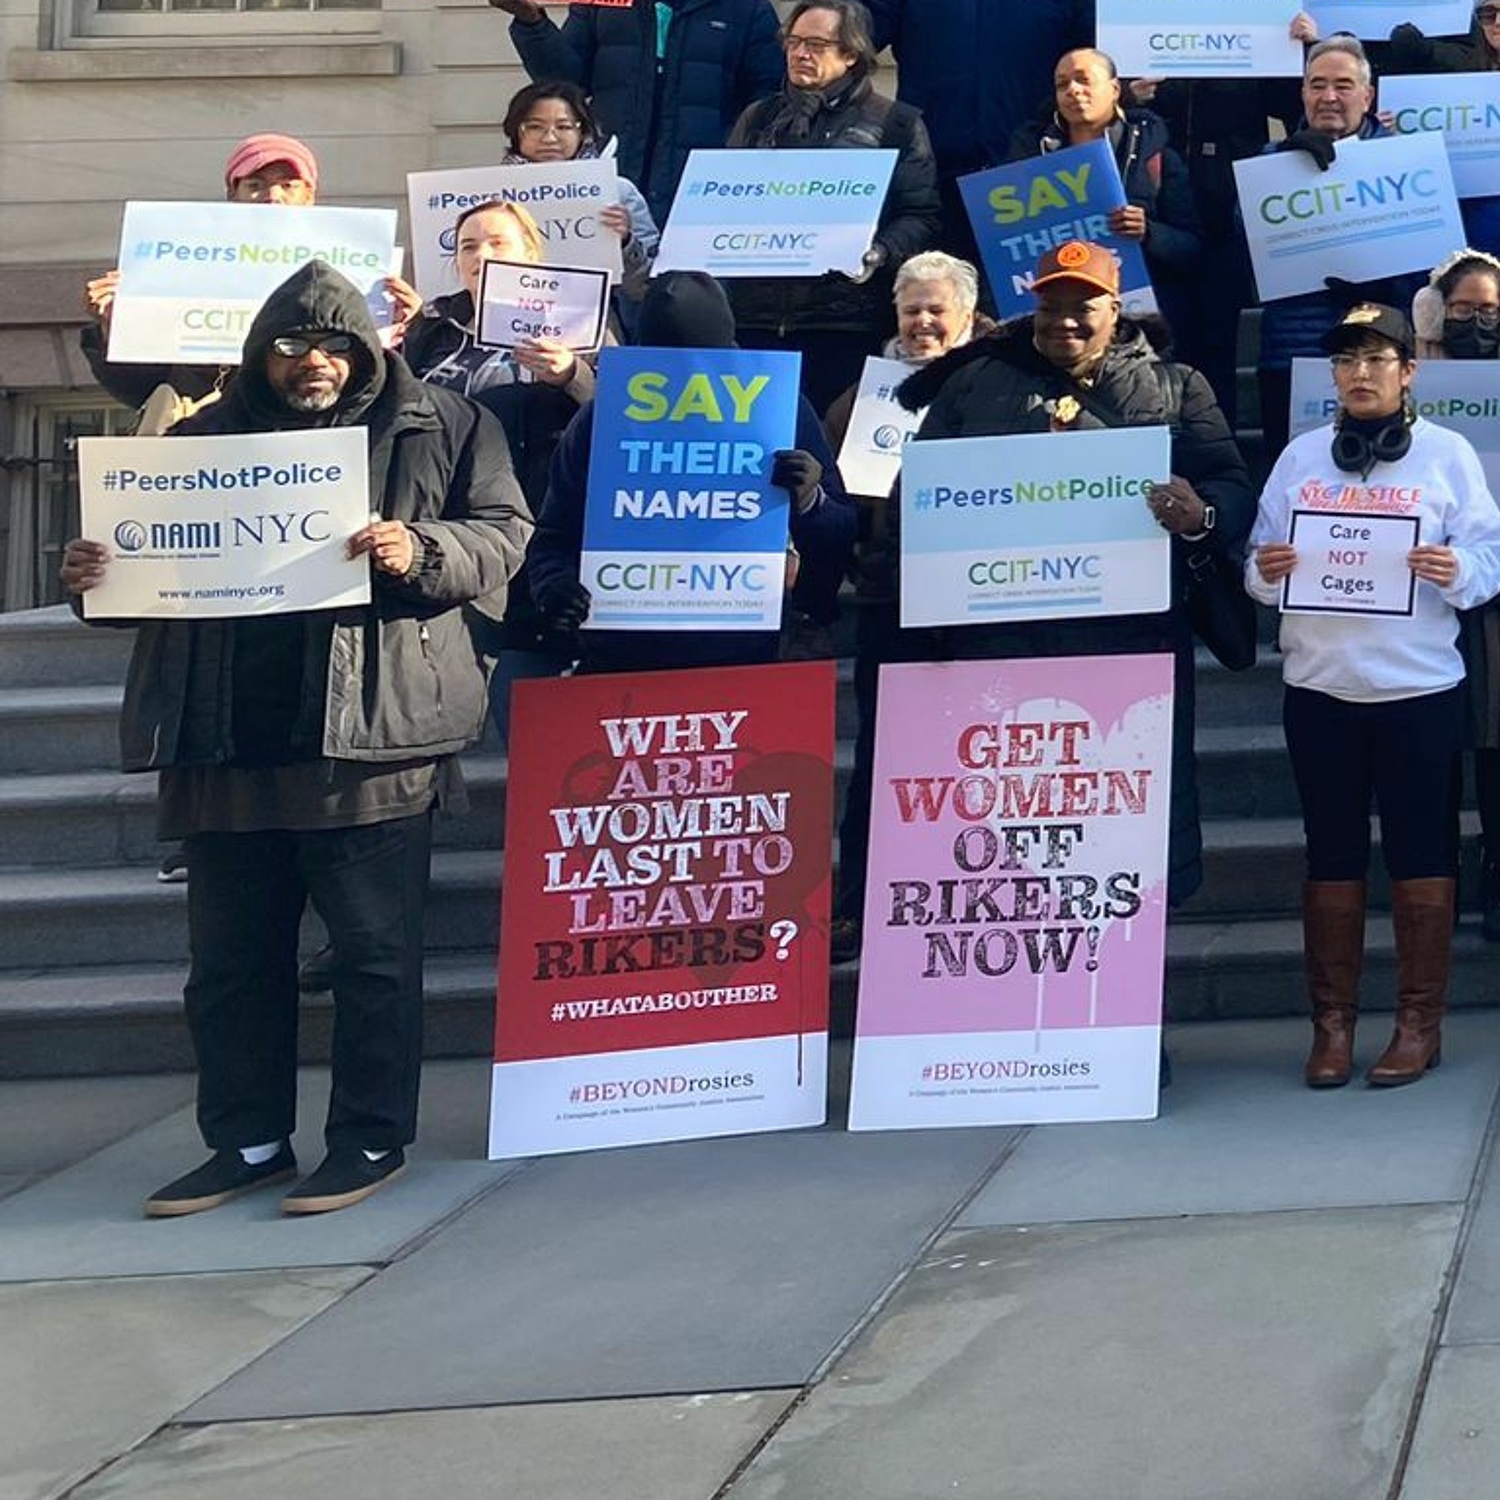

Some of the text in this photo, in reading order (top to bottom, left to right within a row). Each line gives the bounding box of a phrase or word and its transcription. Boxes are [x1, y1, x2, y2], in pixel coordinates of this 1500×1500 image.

[1149, 33, 1253, 51] CCIT-NYC
[686, 179, 878, 198] #PeersNotPolice
[987, 162, 1093, 225] SAY
[1259, 168, 1438, 225] CCIT-NYC
[134, 240, 381, 269] #PeersNotPolice
[712, 232, 819, 251] CCIT-NYC
[1000, 213, 1112, 262] THEIR
[519, 273, 561, 292] Care
[517, 297, 556, 314] NOT
[510, 318, 563, 340] Cages
[622, 371, 772, 424] SAY
[619, 439, 765, 476] THEIR
[103, 462, 342, 492] #PeersNotPolice
[913, 475, 1156, 511] #PeersNotPolice
[612, 489, 762, 520] NAMES
[151, 510, 332, 550] NAMI NYC
[1329, 523, 1371, 540] Care
[967, 555, 1102, 586] CCIT-NYC
[1328, 551, 1368, 565] NOT
[158, 584, 286, 601] www.naminyc.org
[595, 562, 768, 592] CCIT-NYC
[1321, 575, 1375, 595] Cages
[600, 710, 748, 759] WHY
[955, 721, 1091, 771] GET
[608, 753, 735, 800] ARE
[889, 769, 1153, 824] WOMEN
[549, 792, 791, 849] WOMEN
[543, 833, 793, 894] LAST TO
[953, 823, 1085, 874] OFF
[568, 880, 766, 935] LEAVE
[886, 871, 1143, 928] RIKERS
[533, 920, 799, 982] RIKERS?
[921, 925, 1102, 980] NOW!
[550, 983, 778, 1023] #WHATABOUTHER
[569, 1070, 755, 1104] #BEYONDrosies
[922, 1058, 1091, 1081] #BEYONDrosies
